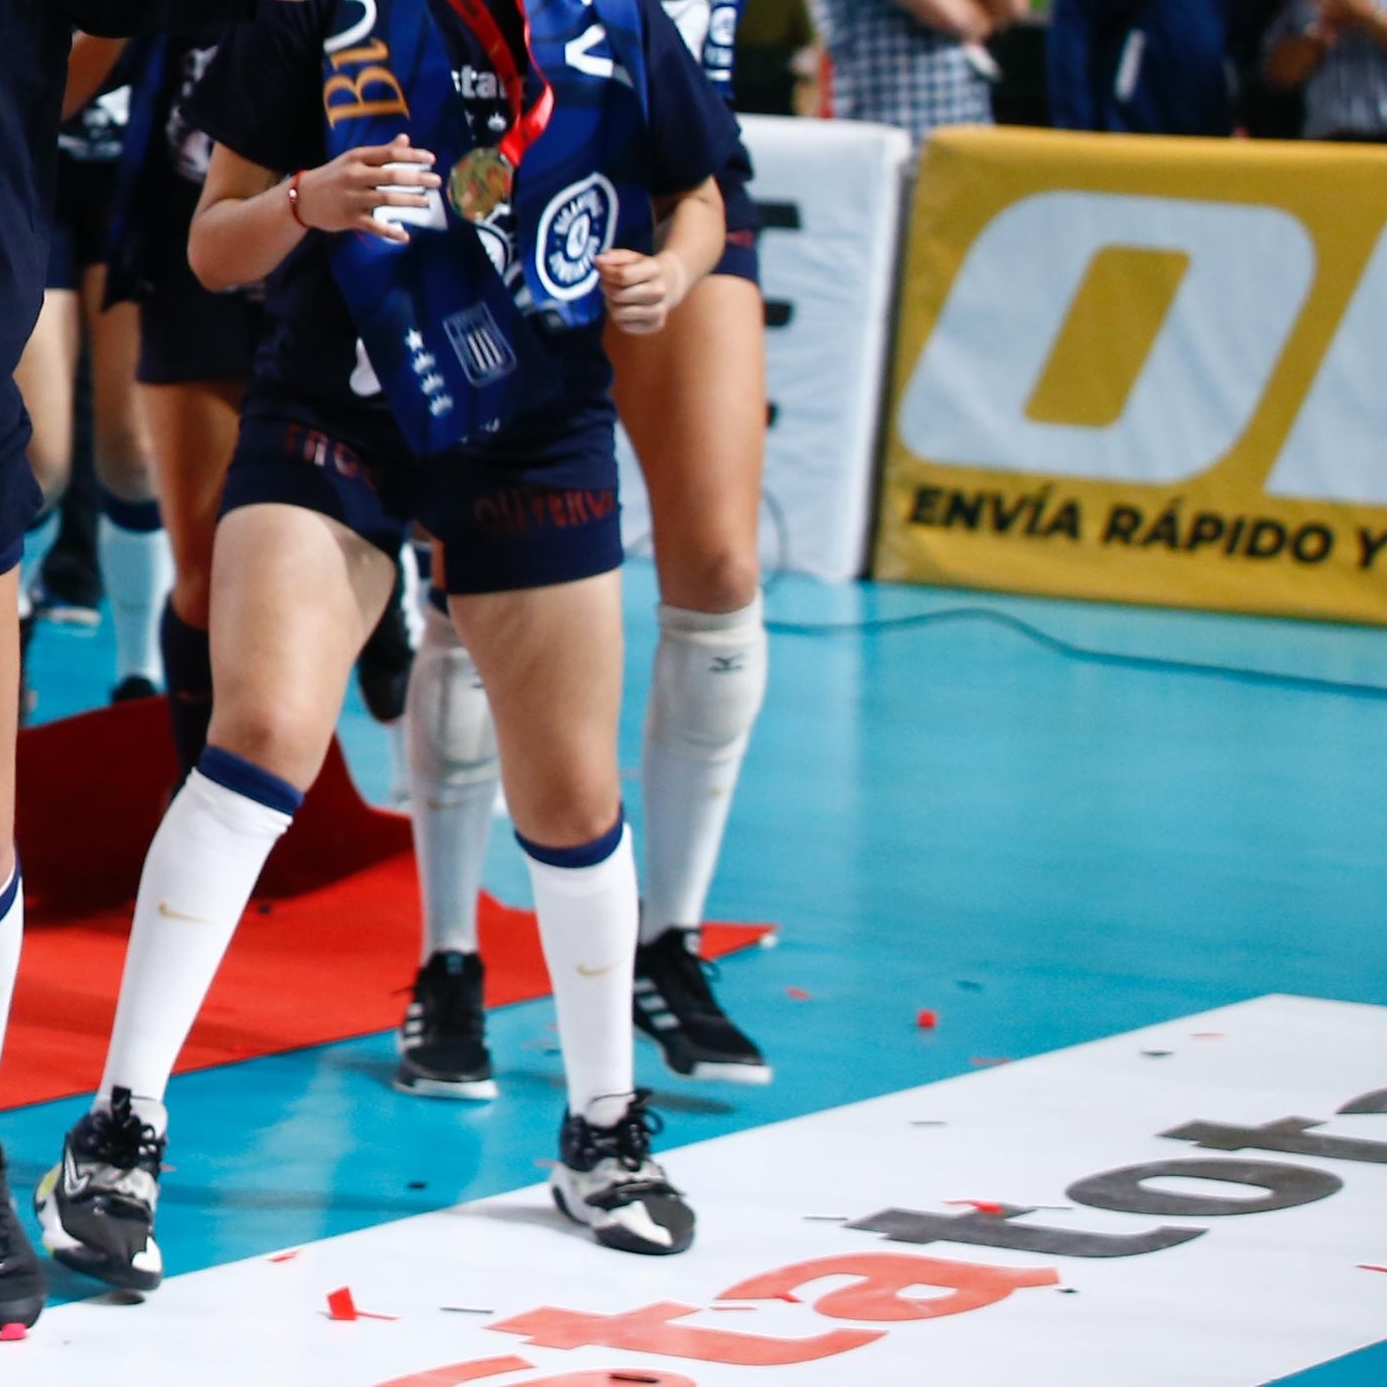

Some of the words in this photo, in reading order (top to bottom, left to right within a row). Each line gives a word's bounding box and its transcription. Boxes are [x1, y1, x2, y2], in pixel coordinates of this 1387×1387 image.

[909, 482, 1081, 541] ENVÍA
[1102, 496, 1335, 564] RÁPIDO
[1356, 527, 1387, 570] Y
